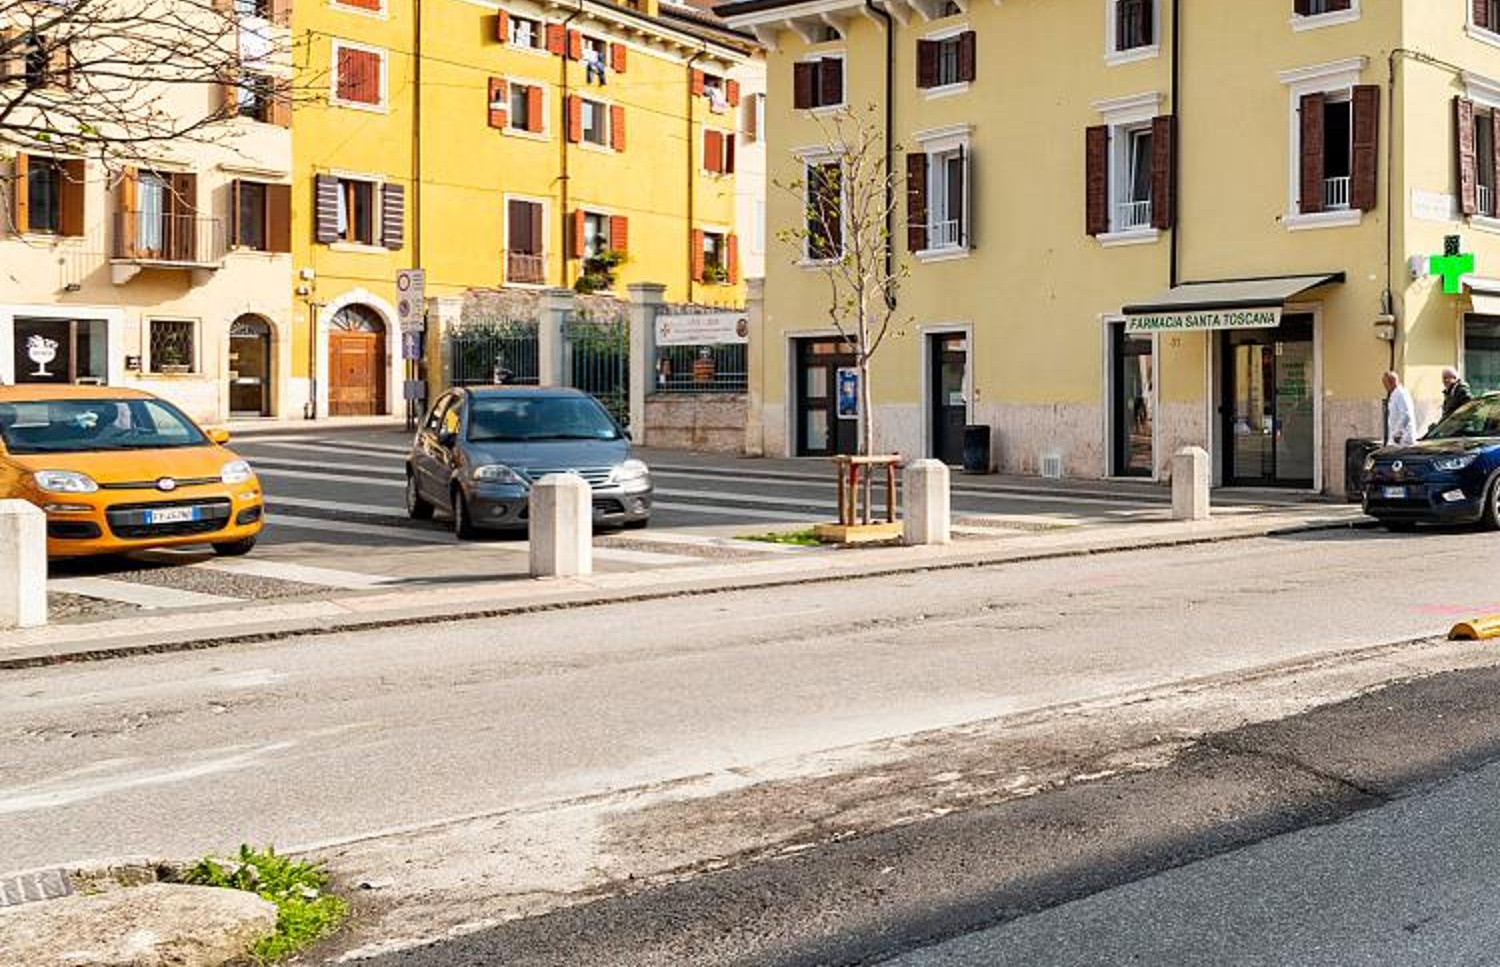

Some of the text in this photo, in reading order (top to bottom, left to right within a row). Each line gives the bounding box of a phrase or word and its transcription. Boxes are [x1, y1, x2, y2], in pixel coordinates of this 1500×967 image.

[1129, 312, 1275, 329] FARMACIA SANTA TOSCANA
